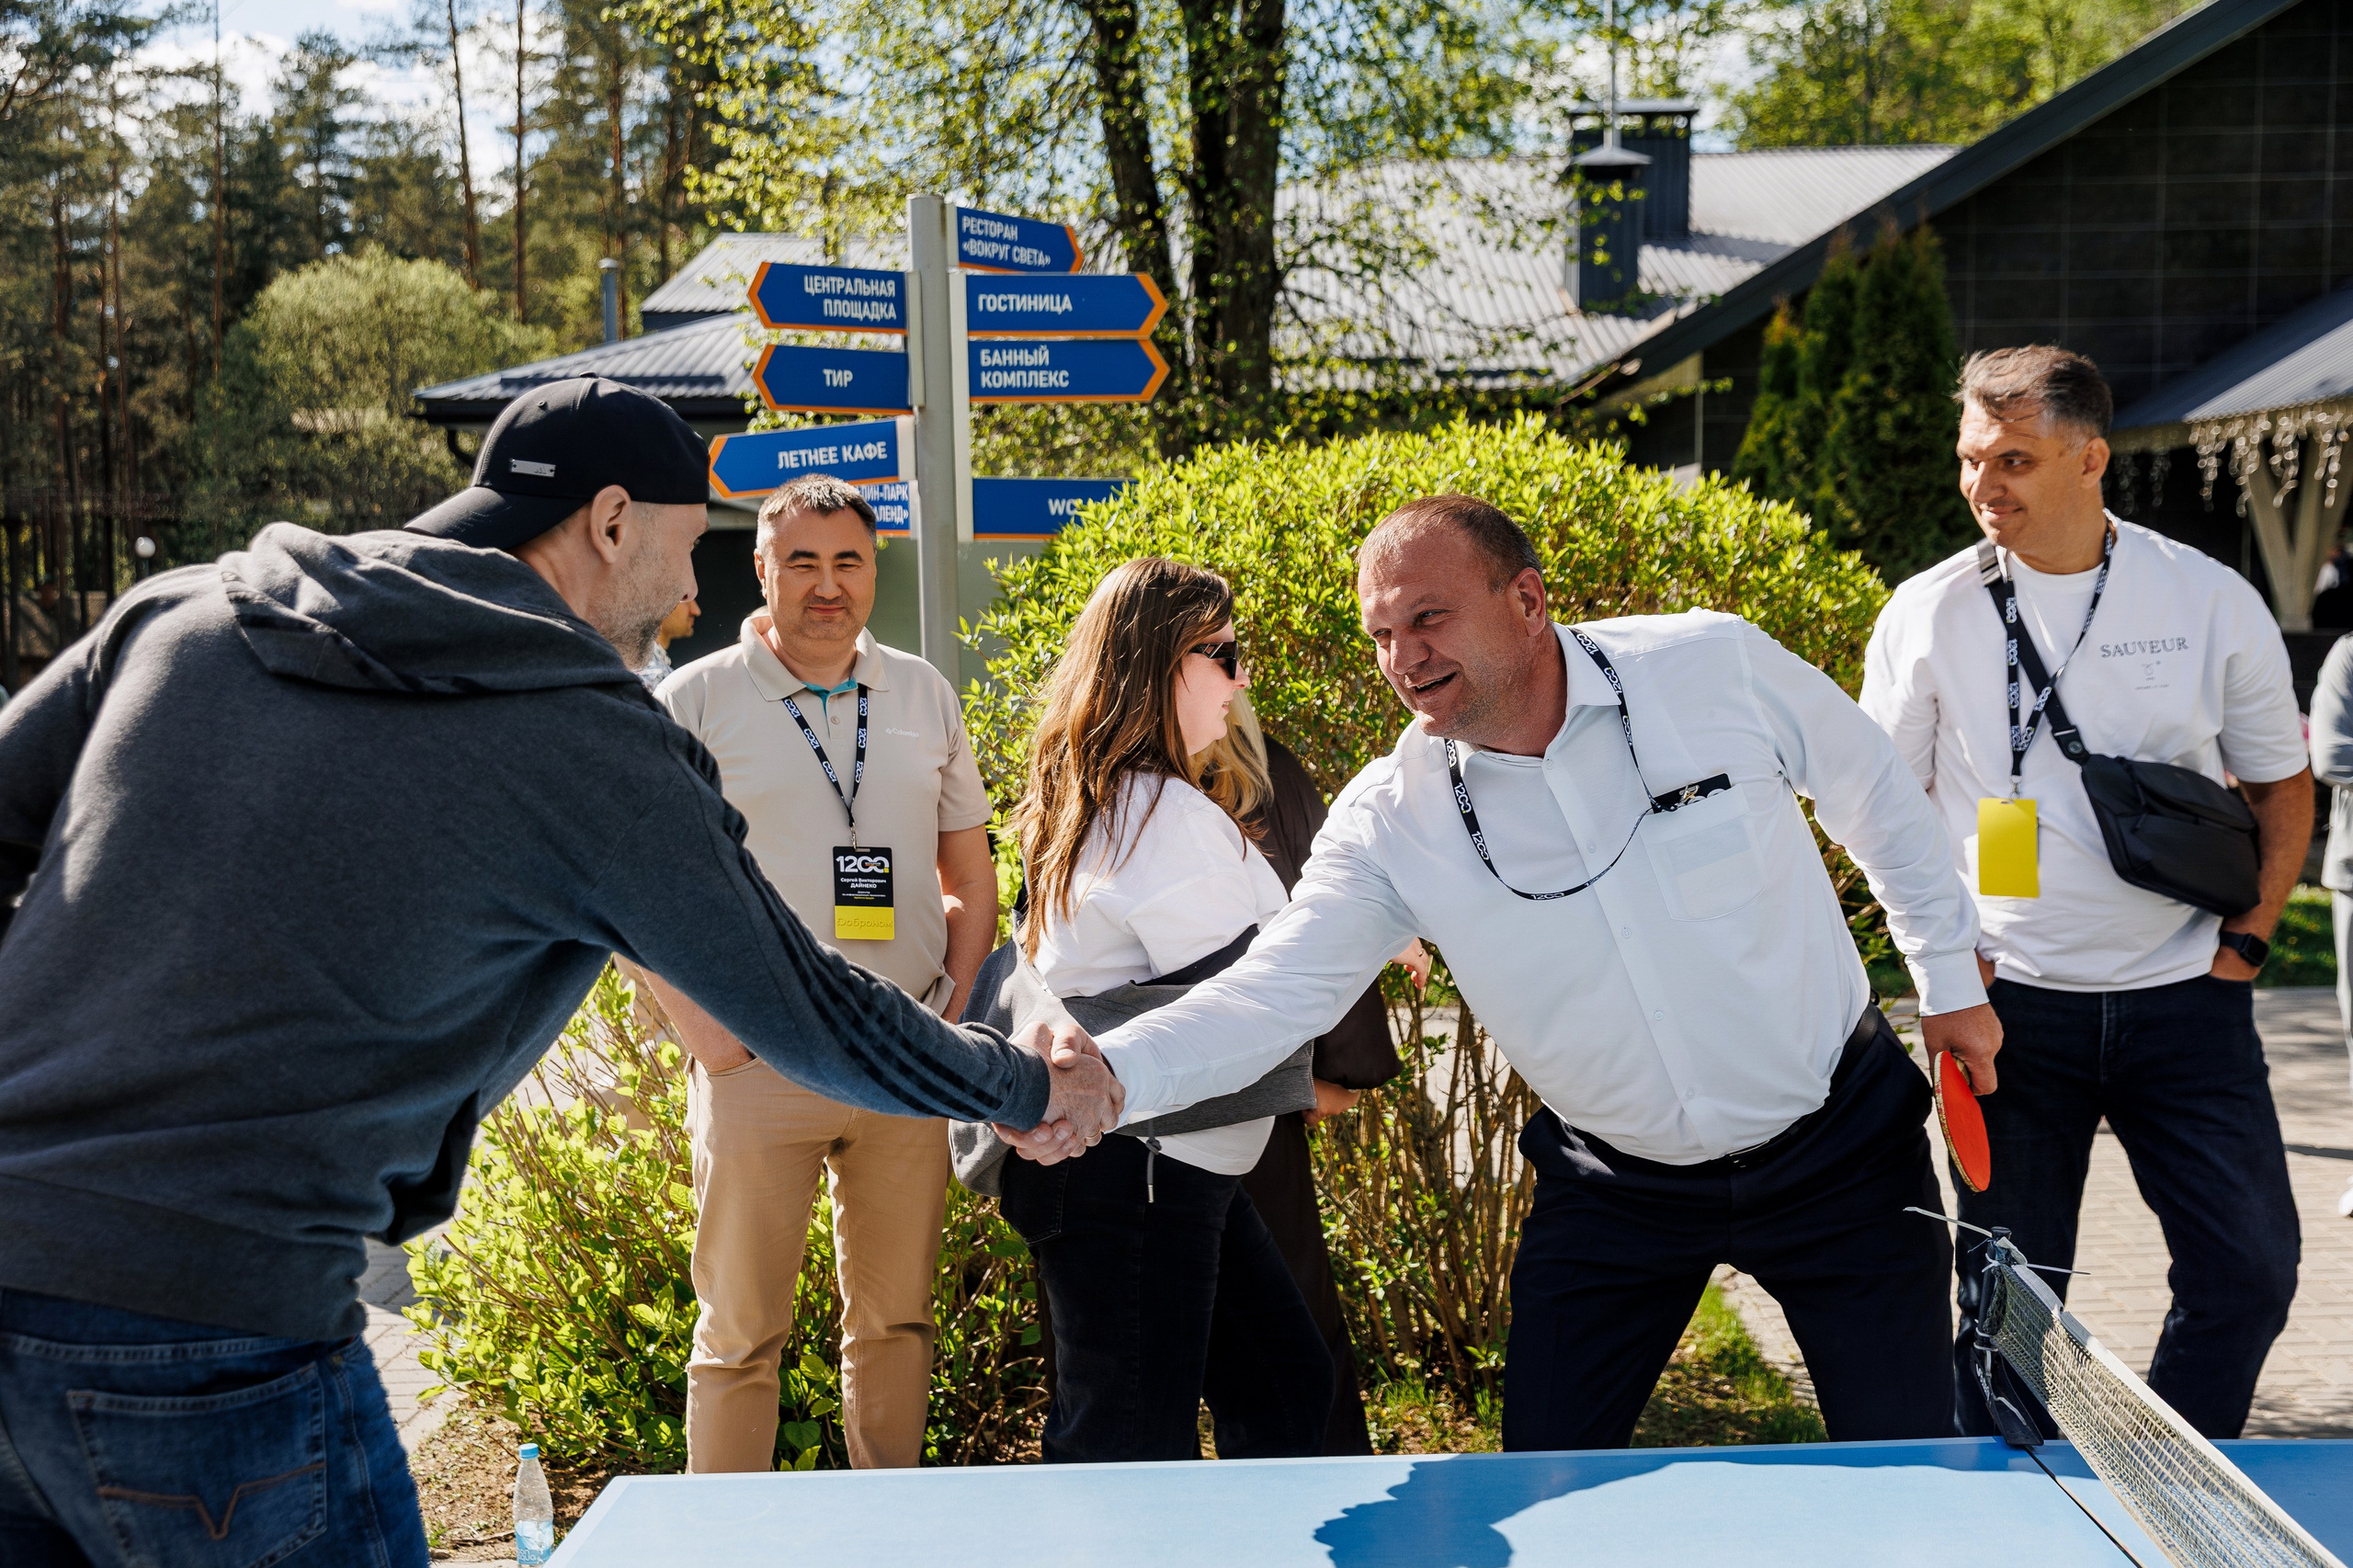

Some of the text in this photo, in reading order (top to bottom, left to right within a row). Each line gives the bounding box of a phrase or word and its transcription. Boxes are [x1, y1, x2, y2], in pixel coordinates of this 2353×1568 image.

[962, 215, 1018, 242] РЕСТОРАН
[962, 238, 1051, 267] «ВОКРУГ СВЕТА»
[804, 275, 896, 298] ЦЕНТРАЛЬНАЯ
[823, 299, 897, 323] ПЛОЩАДКА
[978, 293, 1074, 315] ГОСТИНИЦА
[980, 345, 1050, 367] БАННЫЙ
[822, 369, 854, 388] ТИР
[981, 369, 1070, 388] КОМПЛЕКС
[777, 441, 888, 470] ЛЕТНЕЕ КАФЕ
[1048, 497, 1077, 517] WC
[1576, 632, 1600, 655] 1200
[2099, 636, 2189, 659] SAUVEUR
[1603, 666, 1623, 696] 1200
[784, 699, 801, 719] 1200
[858, 697, 868, 717] 1200
[803, 728, 821, 750] 1200
[858, 728, 867, 748] 1200
[1445, 738, 1458, 768] 1200
[822, 761, 837, 783] 1200
[855, 761, 864, 784] 1200
[1453, 781, 1472, 814] 1200
[1471, 830, 1490, 861] 1200
[835, 855, 891, 874] 1200
[1530, 892, 1565, 901] 1200
